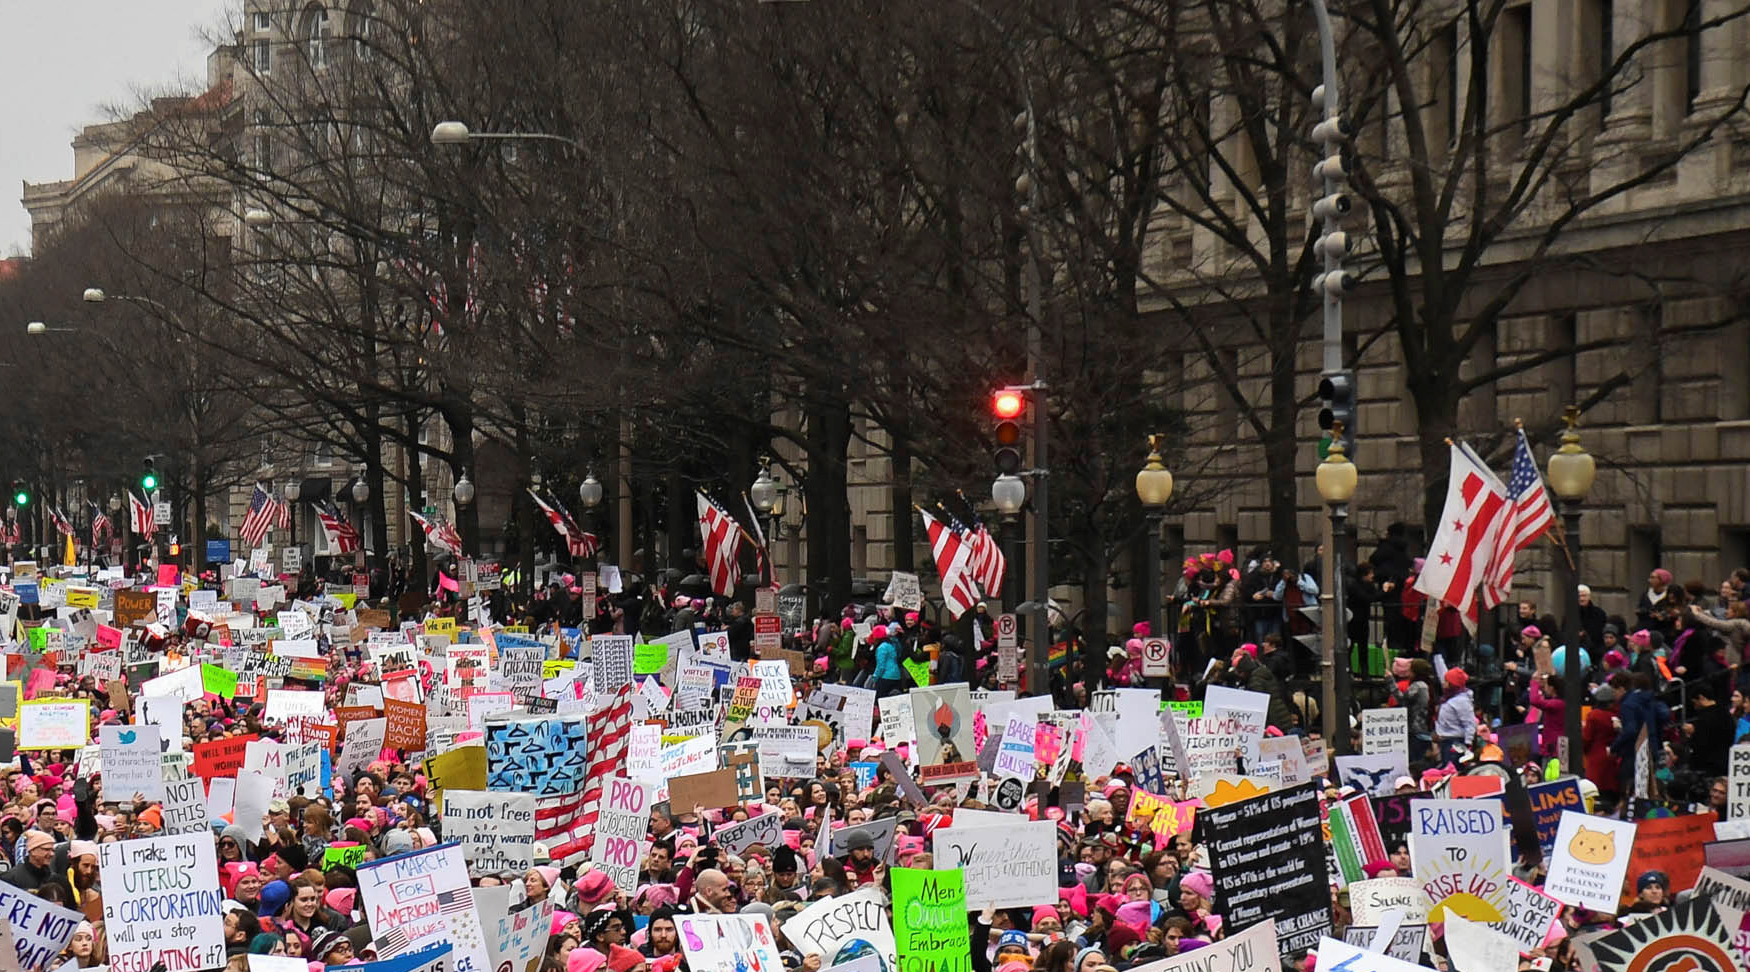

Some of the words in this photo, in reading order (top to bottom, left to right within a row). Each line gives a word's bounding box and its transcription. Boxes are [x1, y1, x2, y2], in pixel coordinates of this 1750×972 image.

[503, 661, 542, 677] GREATER
[755, 666, 782, 677] FUCK
[389, 706, 423, 715] WOMEN
[389, 715, 420, 724] WON'T
[389, 725, 420, 736] BACK
[389, 734, 421, 744] DOWN
[288, 771, 316, 790] FEMALE
[167, 782, 198, 801] NOT
[610, 781, 643, 813] PRO
[166, 803, 205, 821] THIS
[1212, 812, 1236, 825] Women
[1244, 804, 1261, 817] 51%
[1262, 801, 1268, 809] of
[1271, 797, 1281, 809] US
[1283, 791, 1315, 808] population
[599, 811, 647, 840] WOMEN
[1421, 809, 1494, 834] RAISED
[443, 834, 469, 843] when
[474, 833, 496, 850] any
[501, 834, 534, 844] woman
[1217, 838, 1242, 852] Current
[1244, 825, 1288, 848] representation
[1290, 821, 1297, 831] of
[1297, 817, 1319, 828] Women
[476, 852, 528, 870] unfree
[604, 840, 637, 866] PRO
[1447, 848, 1466, 861] TO
[124, 865, 191, 890] UTERUS
[1564, 876, 1604, 889] AGAINST
[1566, 867, 1605, 880] PUSSIES
[1423, 874, 1463, 905] RISE
[1469, 873, 1496, 898] UP
[1523, 907, 1547, 927] OFF
[804, 901, 884, 954] RESPECT
